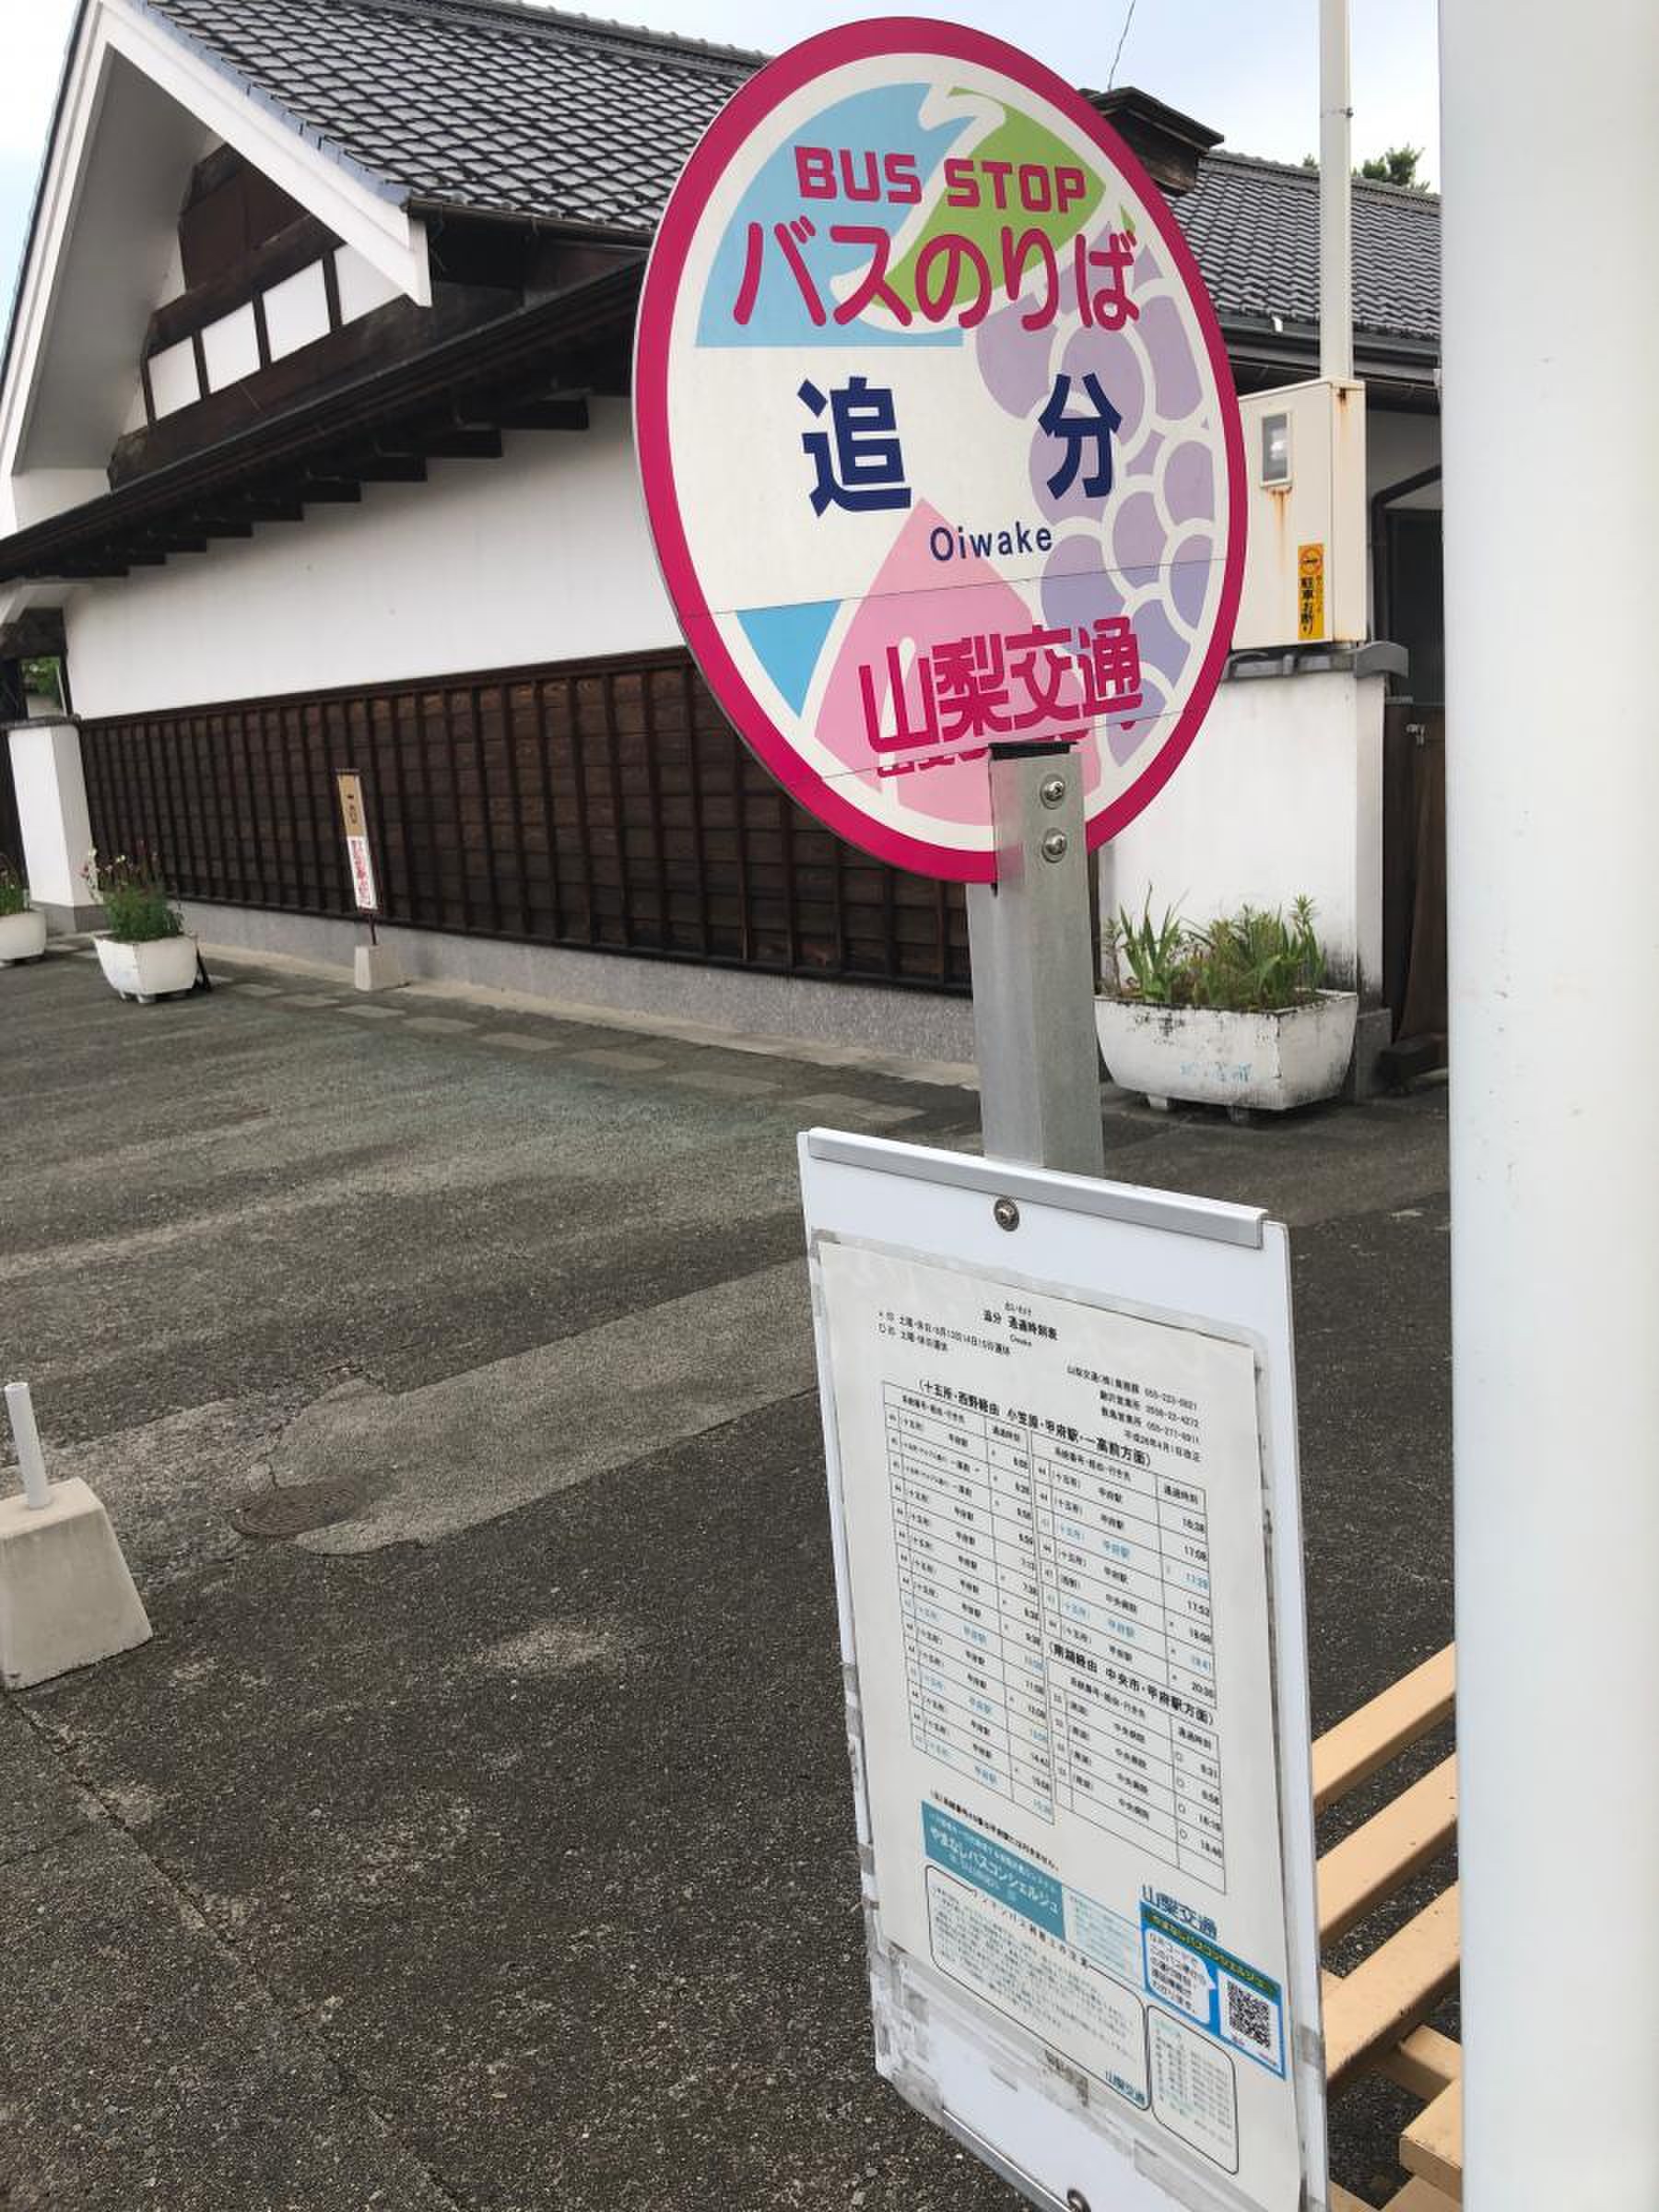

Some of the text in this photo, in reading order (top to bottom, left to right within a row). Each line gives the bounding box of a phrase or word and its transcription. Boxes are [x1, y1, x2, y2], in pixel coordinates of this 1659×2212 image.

[794, 146, 1086, 214] BUS STOP
[734, 216, 1140, 331] バスのりば
[930, 521, 1053, 561] Oiwake
[858, 616, 1143, 753] 山梨交通
